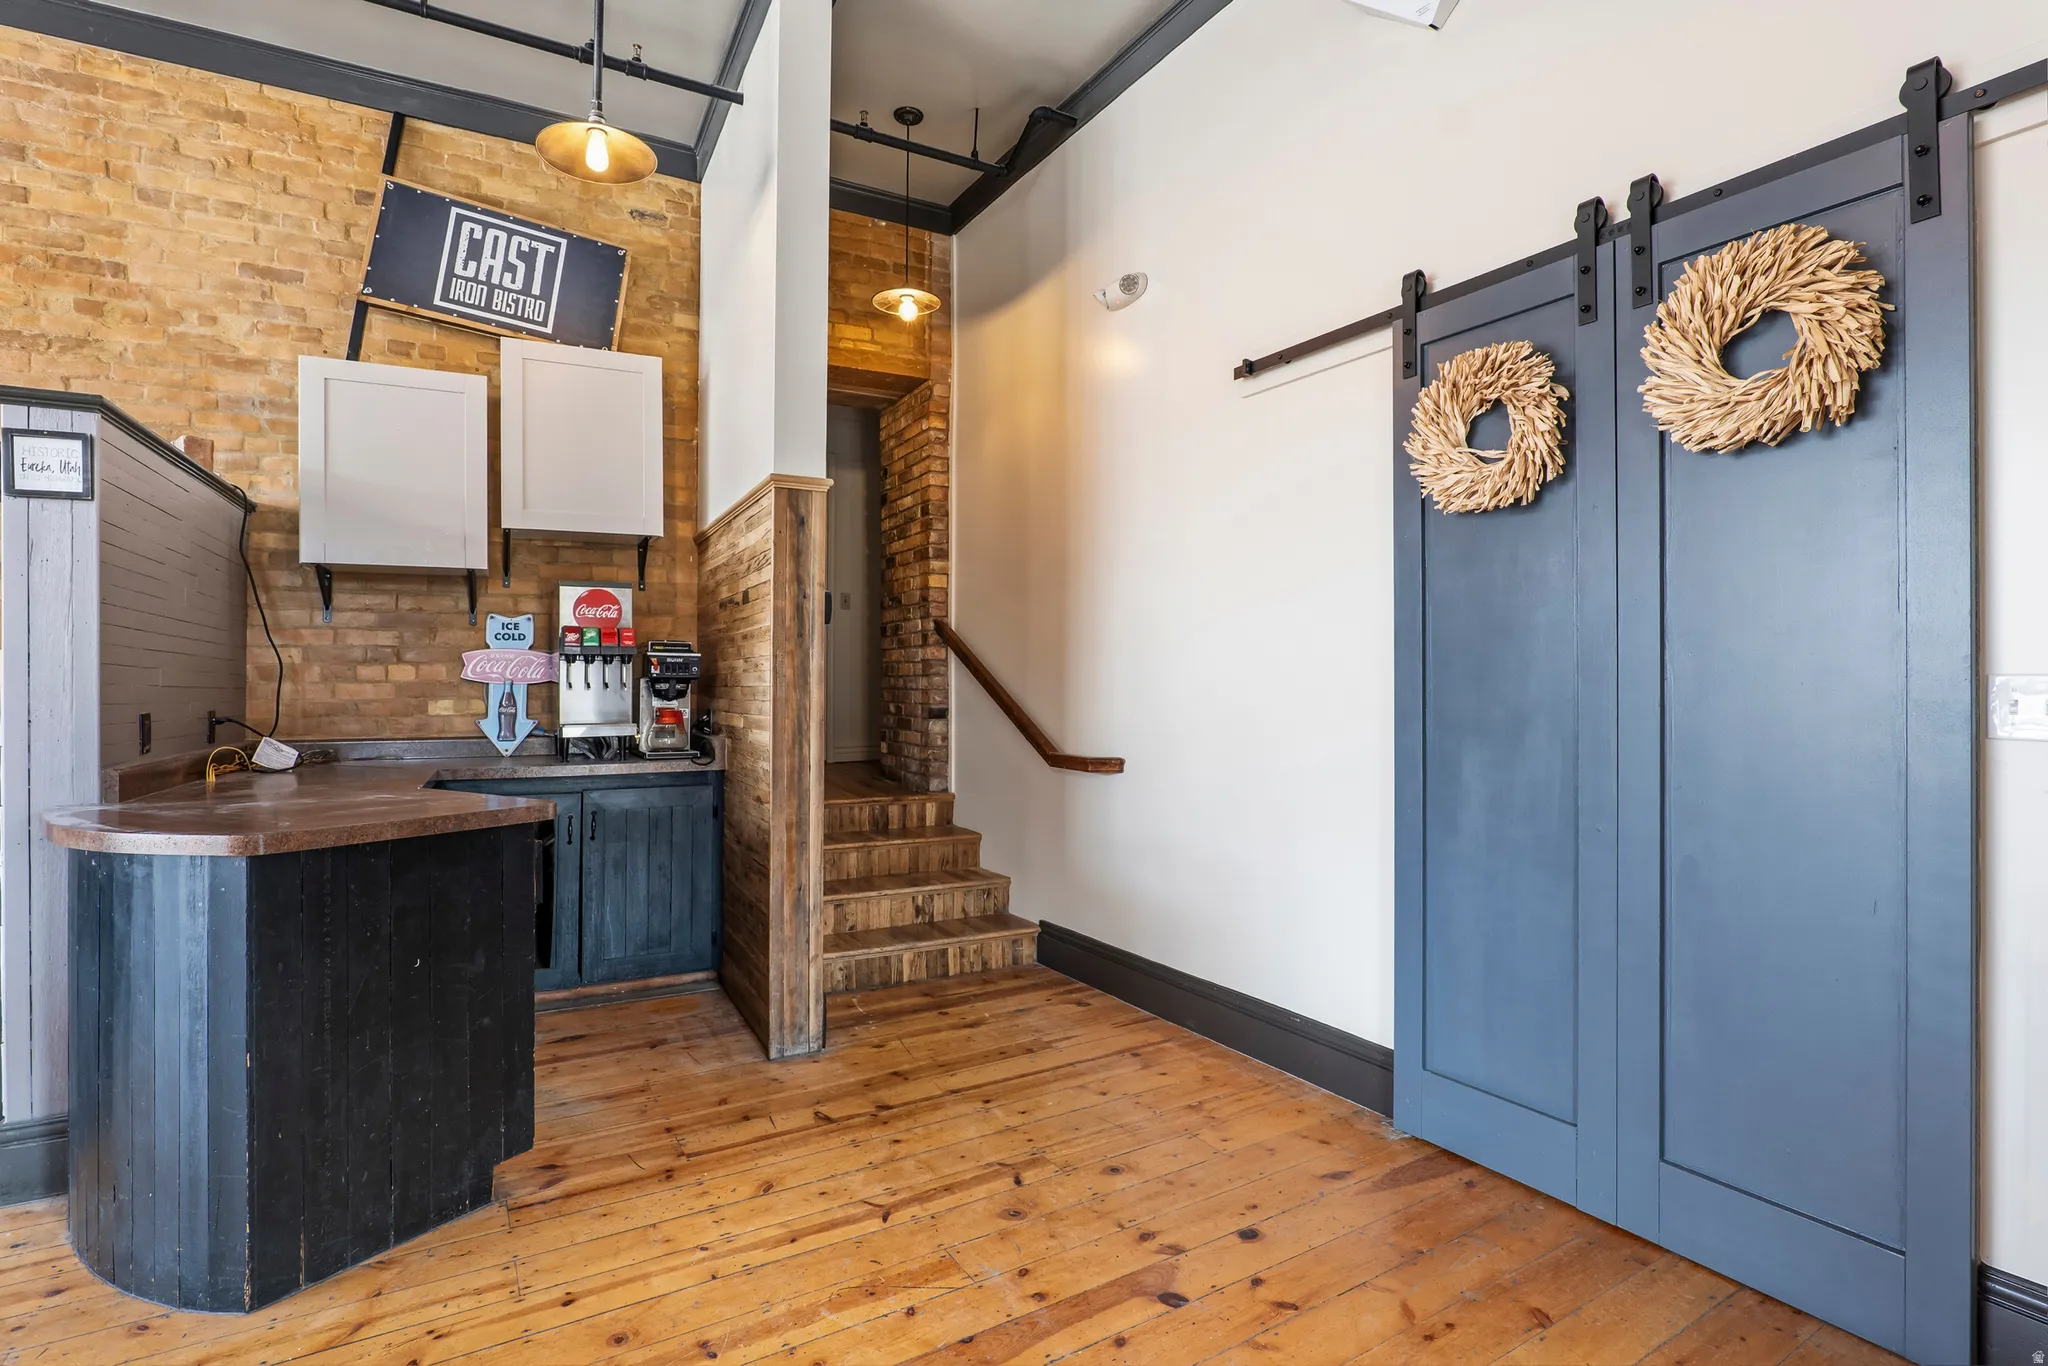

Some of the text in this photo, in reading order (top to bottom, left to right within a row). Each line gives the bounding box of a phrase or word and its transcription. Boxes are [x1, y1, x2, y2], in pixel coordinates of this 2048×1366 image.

[454, 221, 556, 296] CAST
[449, 277, 546, 322] IRON BISTRO
[22, 446, 80, 459] HISTORIC
[21, 457, 81, 476] Eureka, Utah
[575, 603, 621, 618] Coca-Cola
[501, 622, 520, 631] ICE
[494, 632, 526, 641] COLD
[467, 654, 549, 680] Coca-Cola
